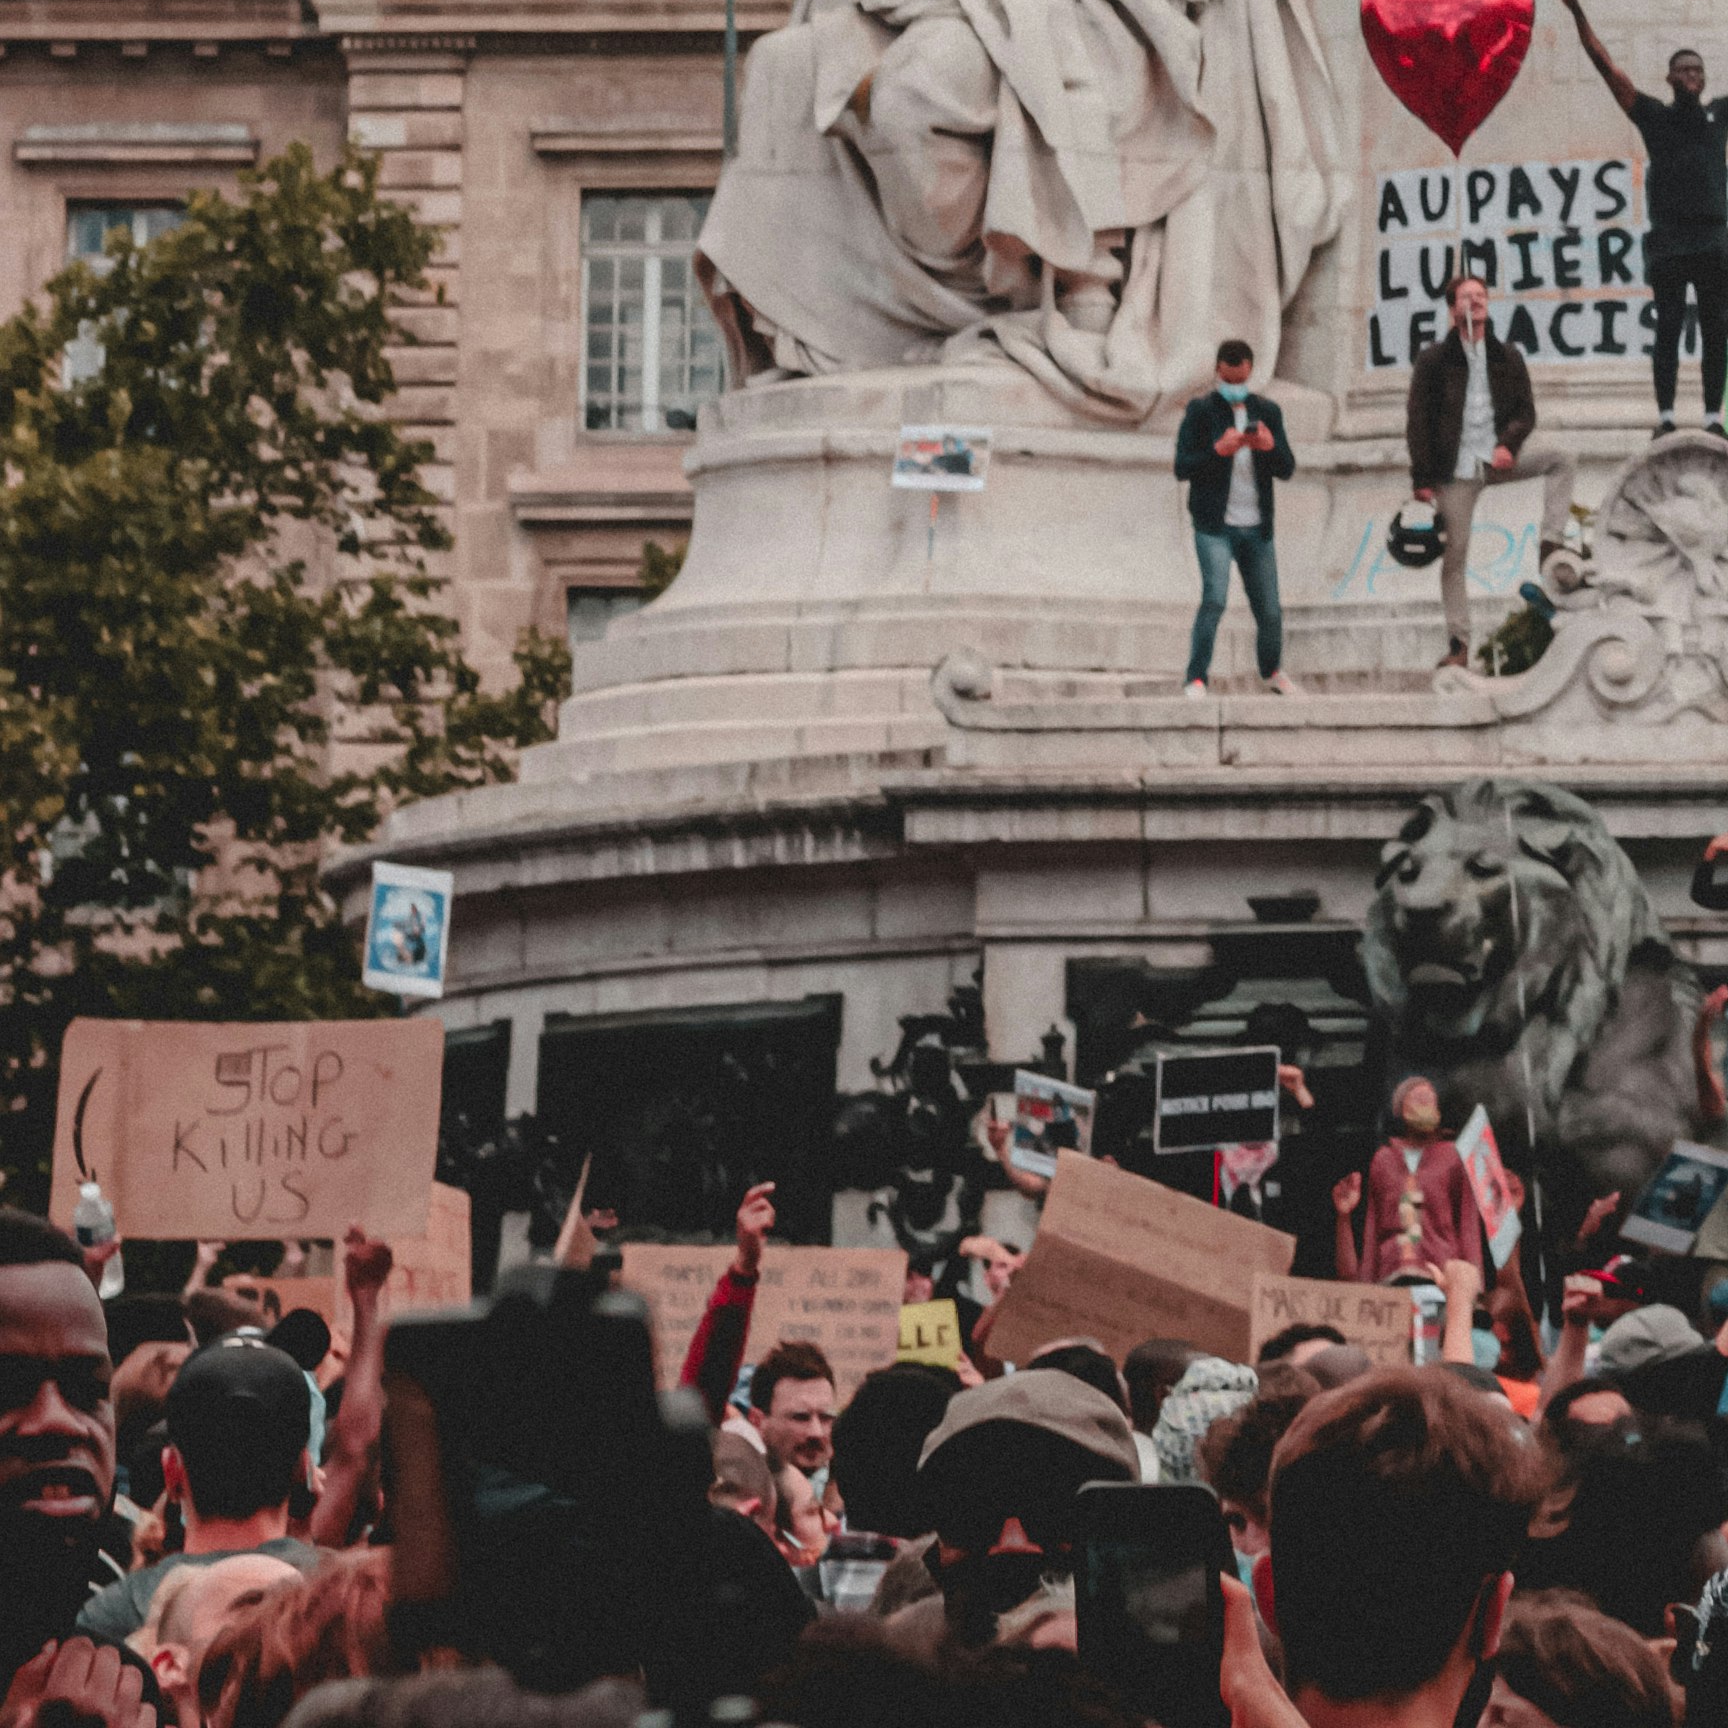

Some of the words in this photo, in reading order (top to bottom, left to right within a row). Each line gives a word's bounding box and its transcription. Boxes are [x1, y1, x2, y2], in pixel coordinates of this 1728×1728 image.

[1378, 176, 1451, 233] AU
[1466, 159, 1628, 225] PAYS
[206, 1043, 345, 1117] STOP
[231, 1168, 311, 1225] US
